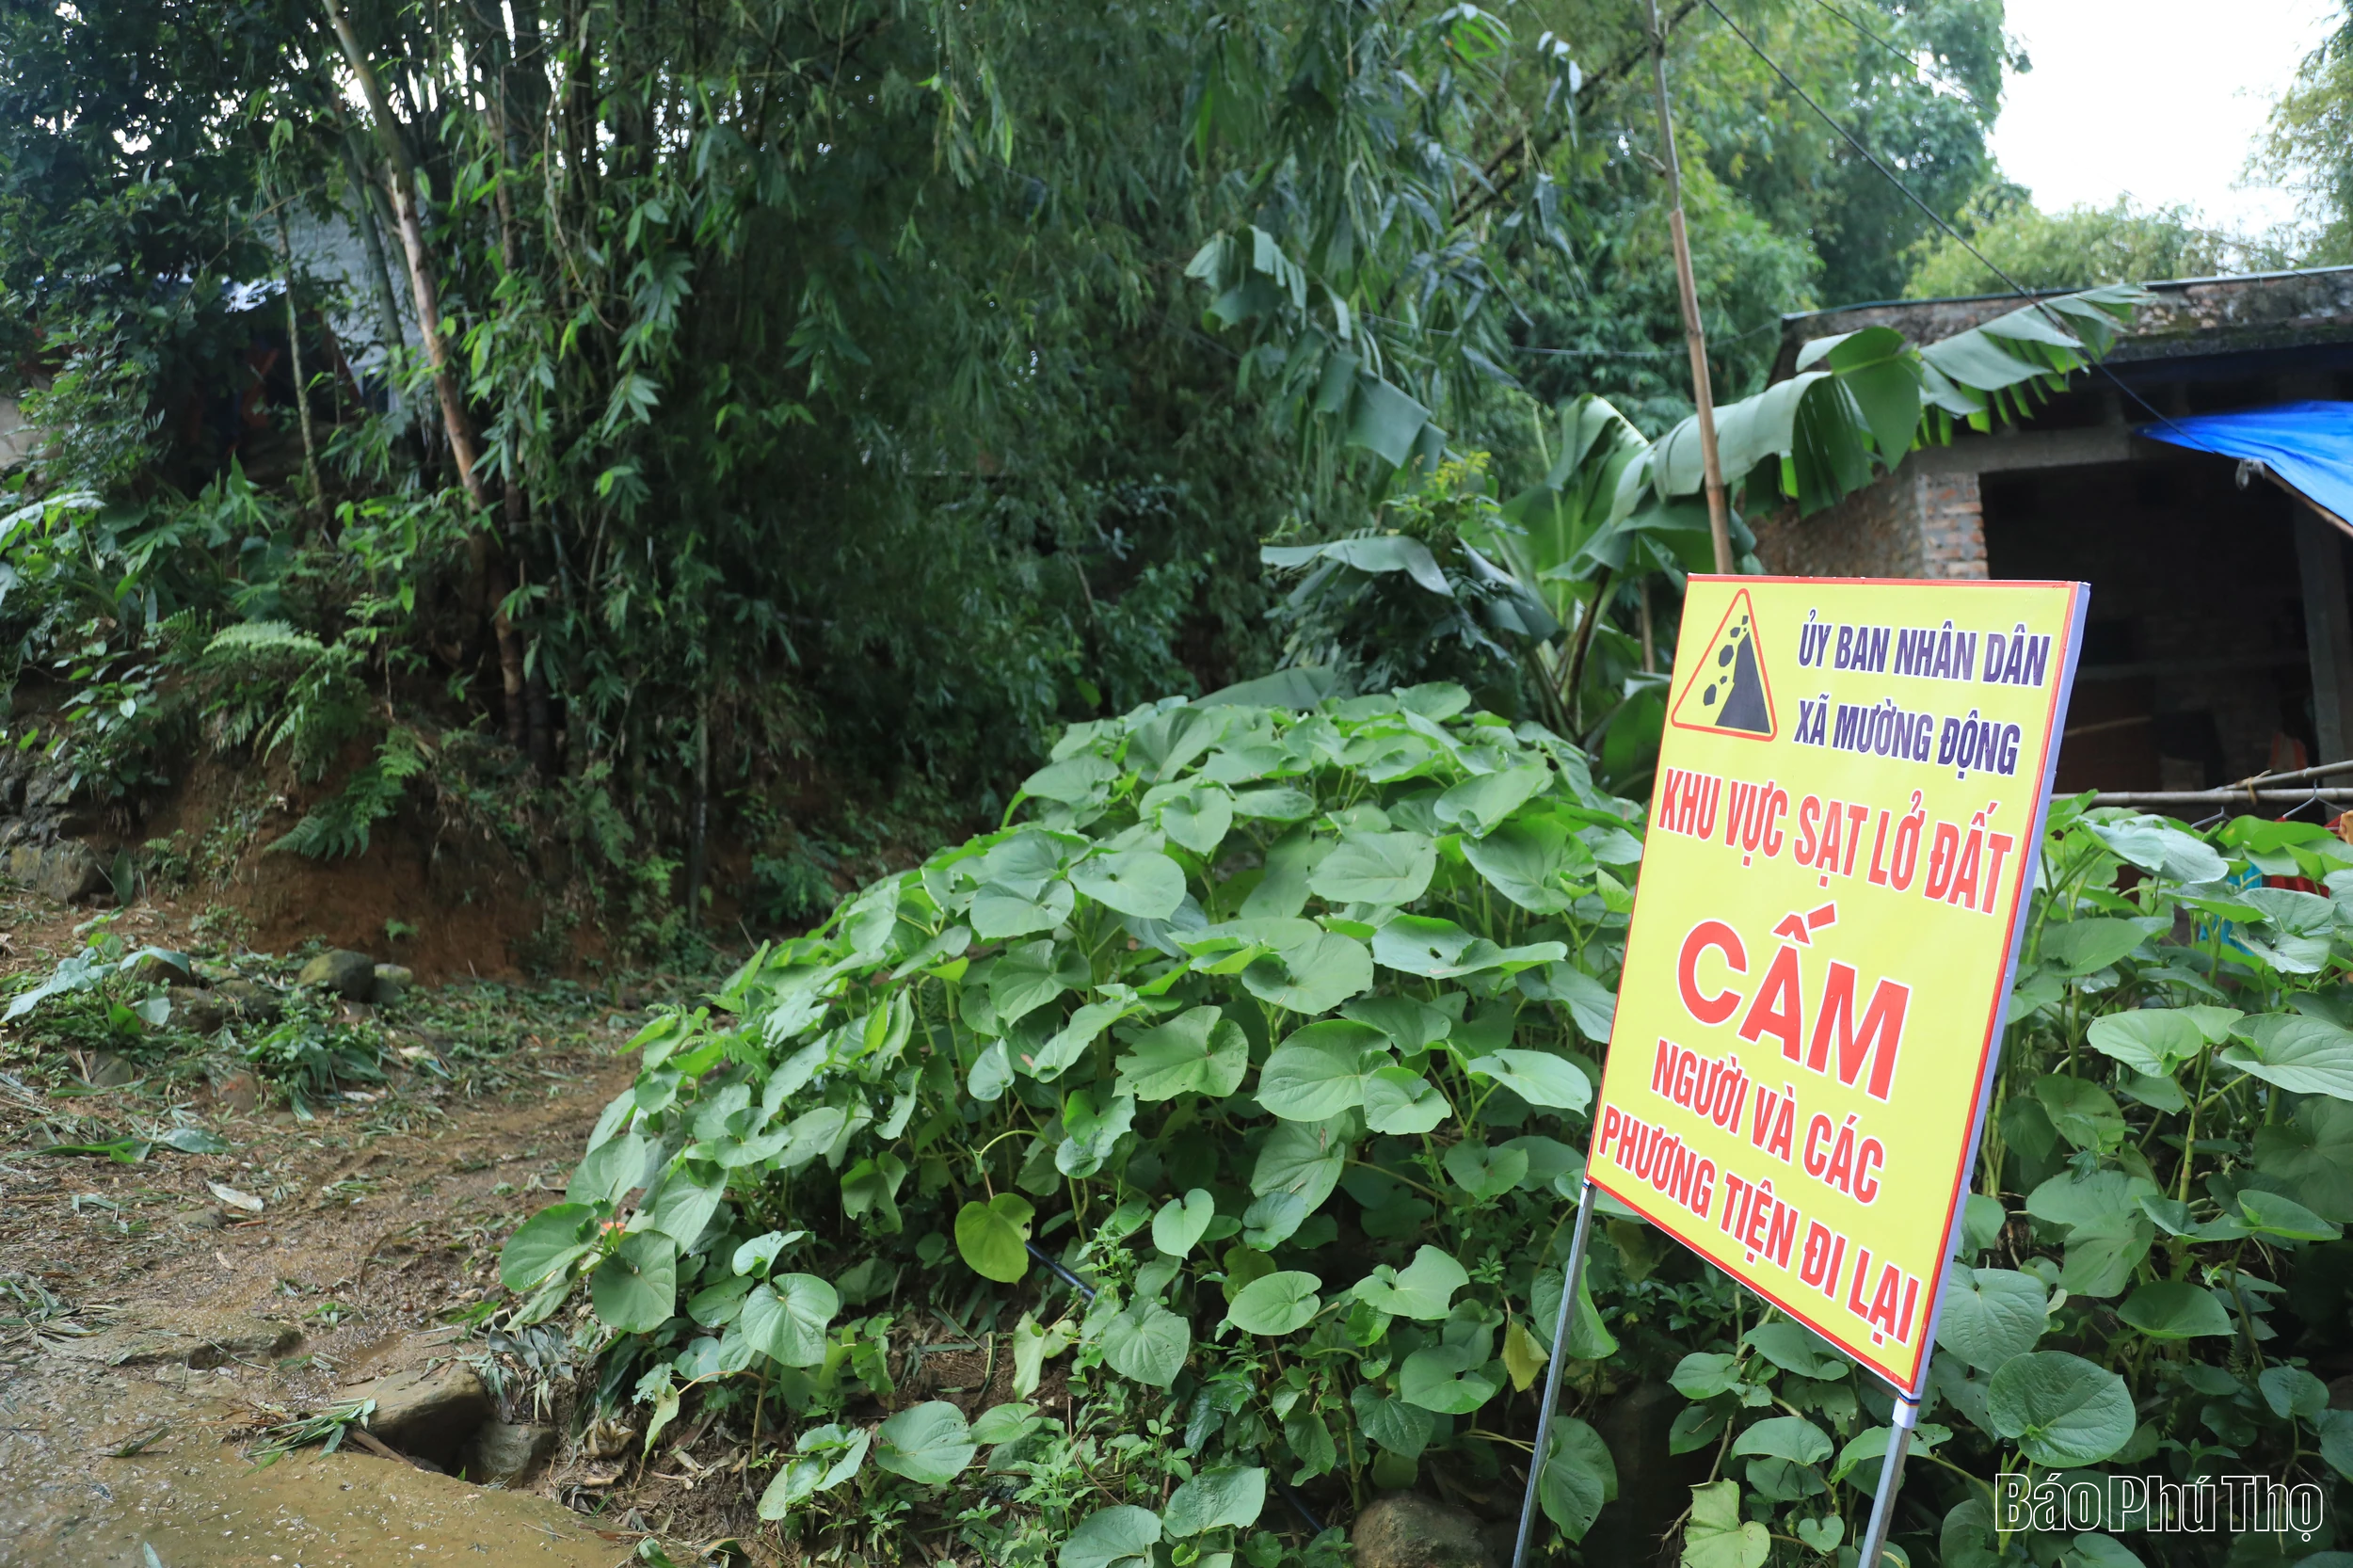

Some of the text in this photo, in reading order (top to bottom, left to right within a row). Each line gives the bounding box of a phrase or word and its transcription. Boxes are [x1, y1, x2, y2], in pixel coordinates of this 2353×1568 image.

[1799, 609, 2051, 686] ỦY BAN NHÂN DÂN
[1794, 695, 2021, 779] XÃ MƯỜNG ĐỘNG
[1658, 769, 2014, 915] KHU VỰC SẠT LỞ ĐẤT
[1677, 902, 1910, 1102] CẤM
[1651, 1039, 1884, 1205] NGƯỜI VÀ CÁC
[1599, 1105, 1921, 1348] PHƯƠNG TIỆN ĐI LẠI
